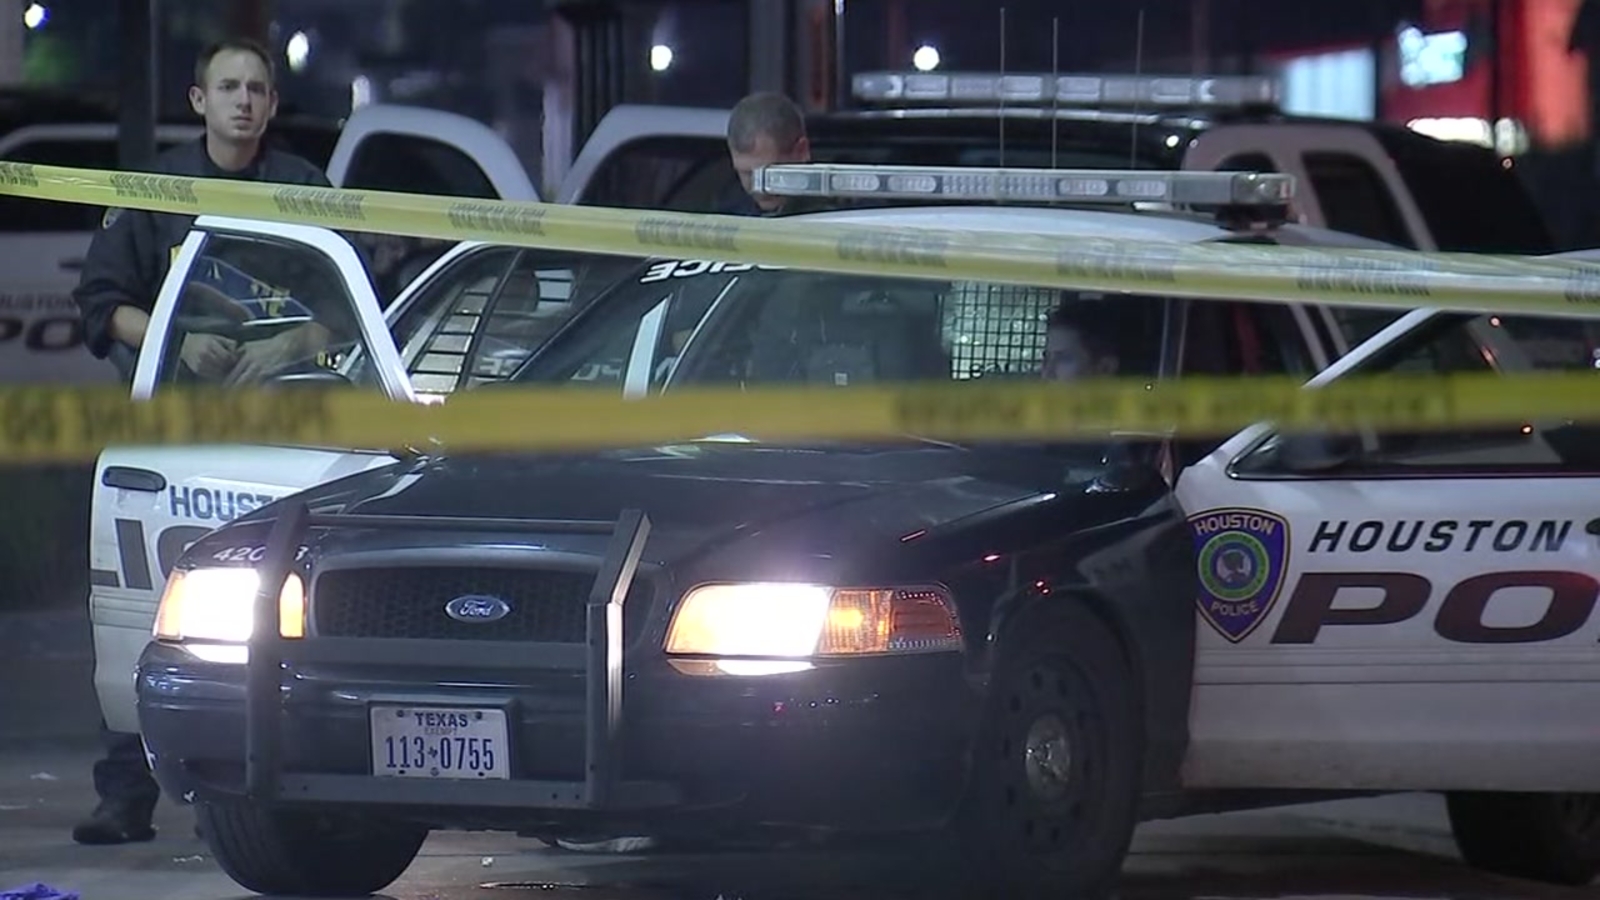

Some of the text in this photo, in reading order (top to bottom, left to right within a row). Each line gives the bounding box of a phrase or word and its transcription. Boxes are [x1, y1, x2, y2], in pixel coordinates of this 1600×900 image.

[1194, 514, 1275, 536] HOUSTON
[1307, 520, 1573, 552] HOUSTON
[459, 599, 495, 616] Ford
[1210, 600, 1260, 616] POLICE
[414, 711, 468, 728] TEXAS
